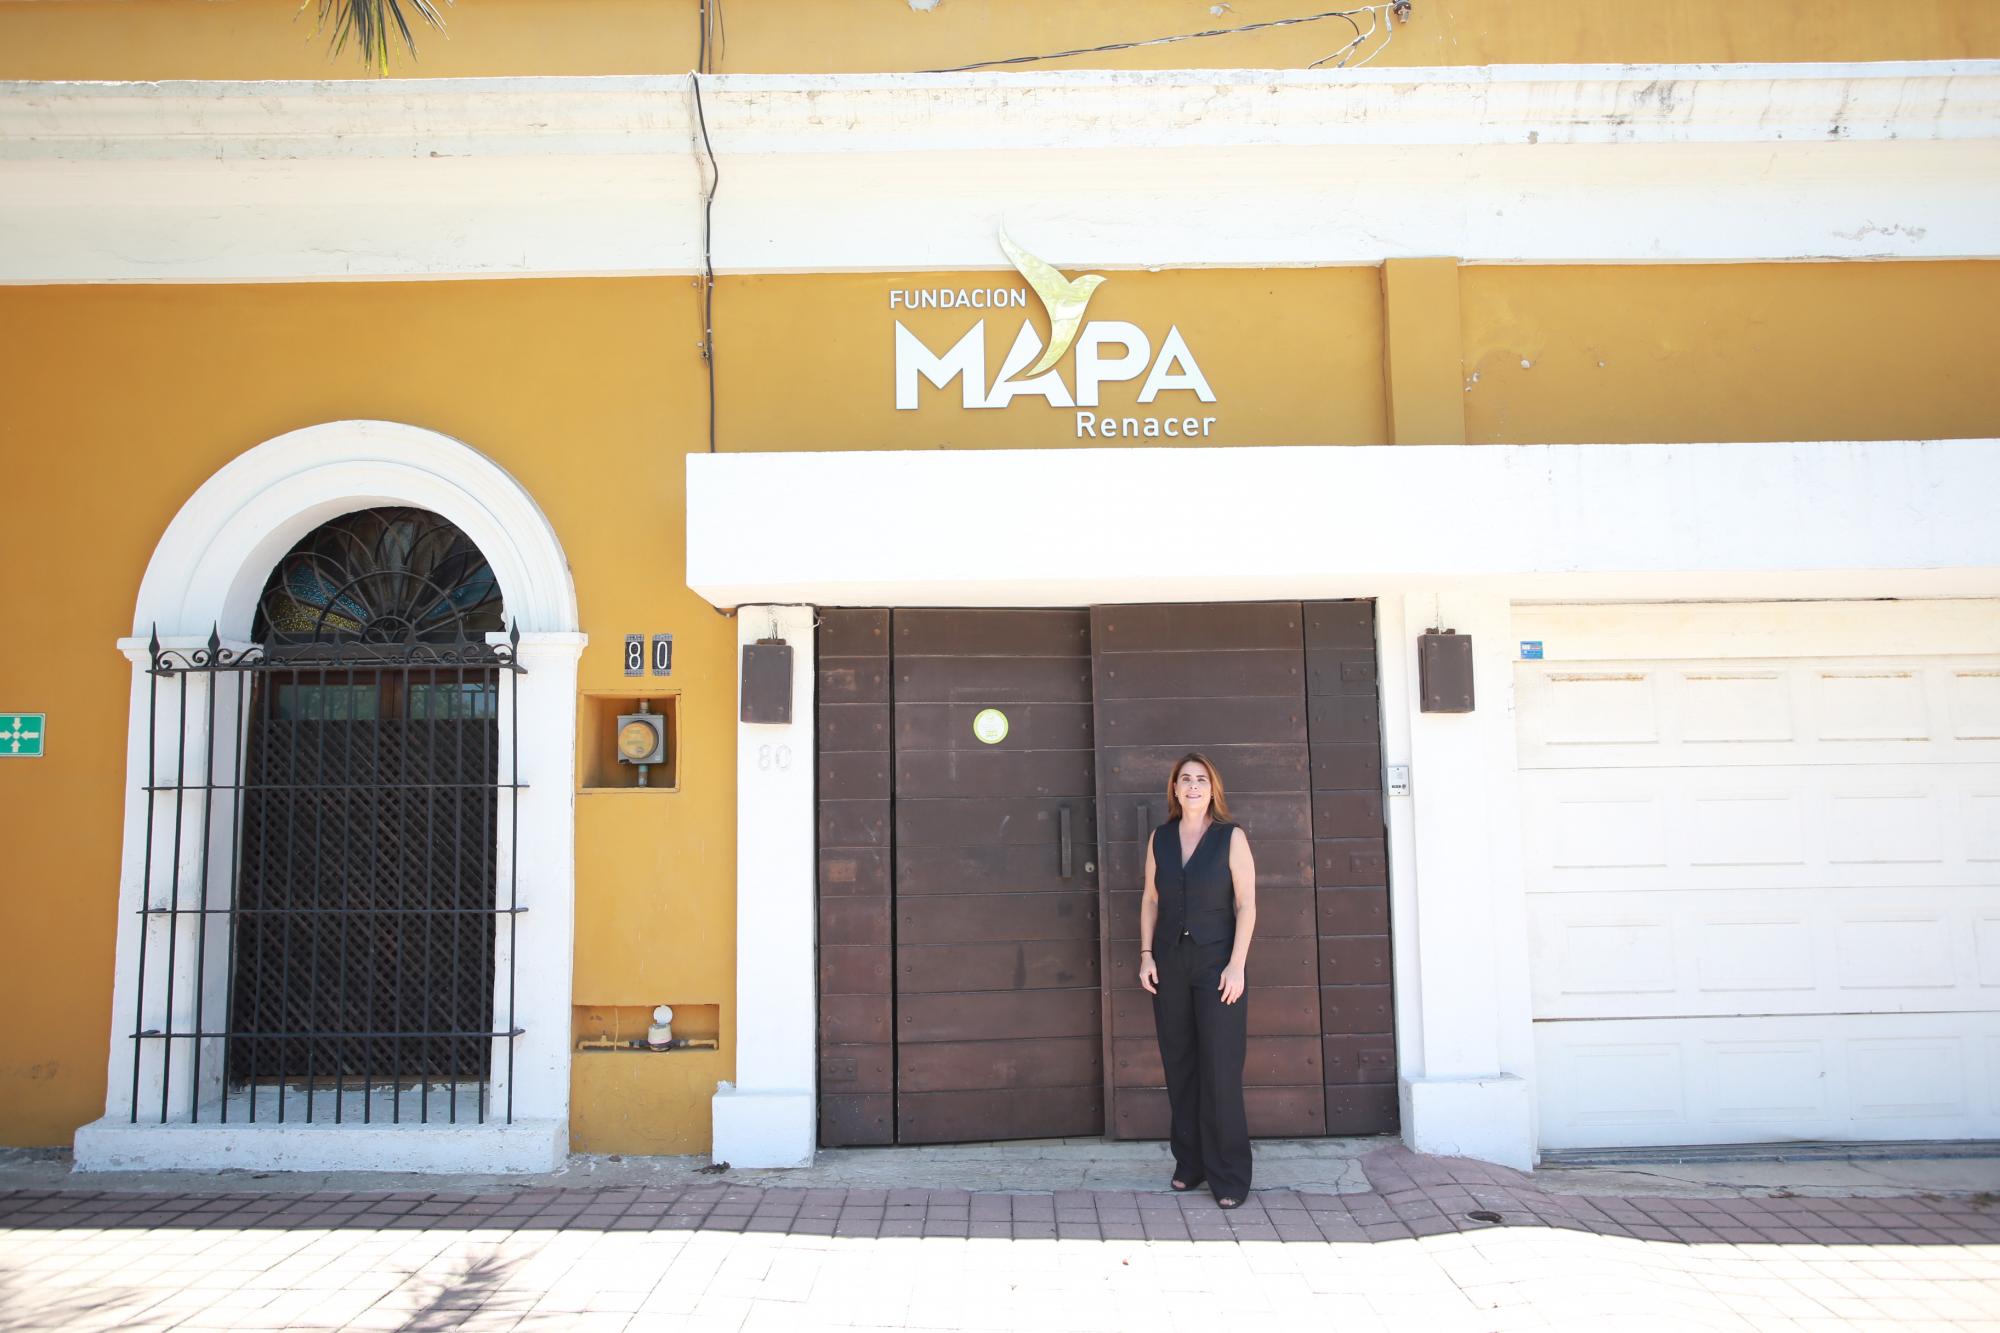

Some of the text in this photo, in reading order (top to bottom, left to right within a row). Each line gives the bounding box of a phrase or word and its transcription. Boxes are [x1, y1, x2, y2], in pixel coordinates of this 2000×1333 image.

[889, 288, 1027, 309] FUNDACION
[895, 317, 1217, 410] MAPA
[1076, 411, 1217, 438] Renacer
[628, 641, 669, 670] 80
